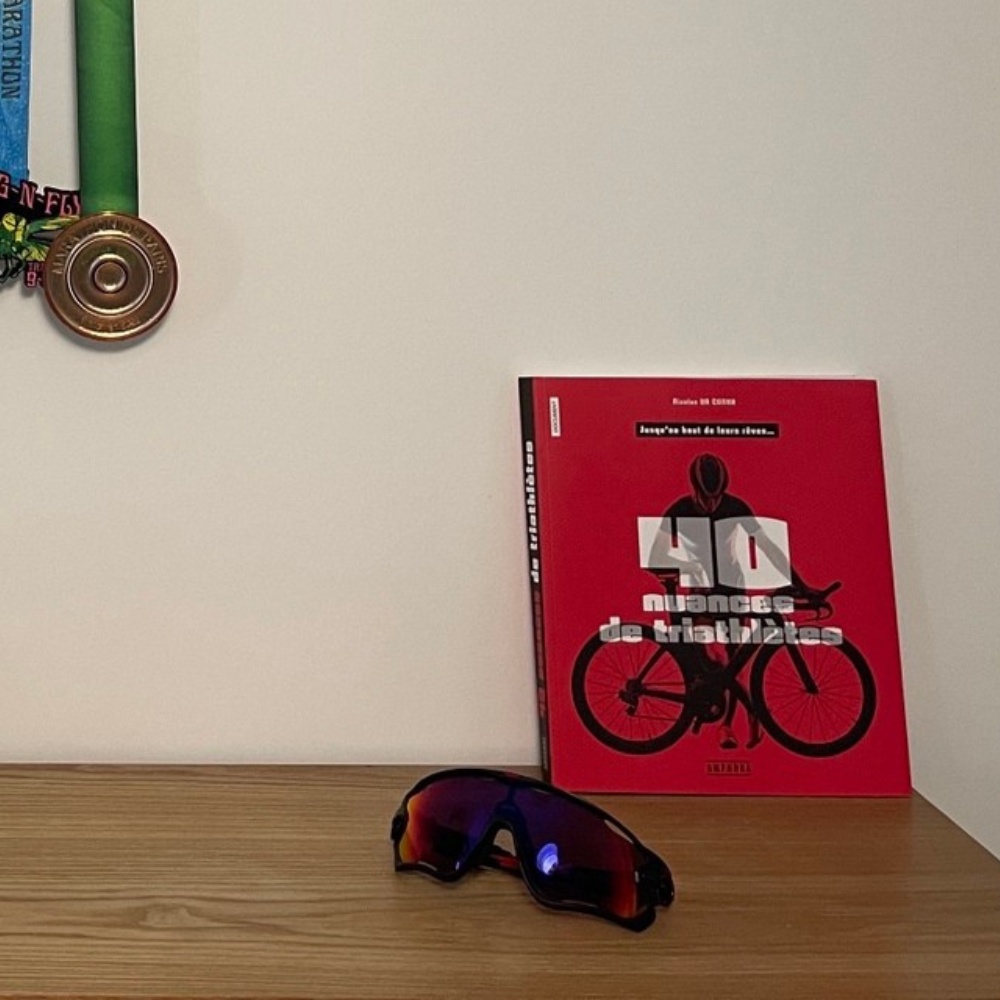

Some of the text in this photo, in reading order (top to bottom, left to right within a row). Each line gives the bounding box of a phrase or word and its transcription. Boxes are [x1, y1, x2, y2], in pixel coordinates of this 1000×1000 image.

[637, 516, 793, 590] 40
[530, 558, 540, 583] de
[642, 593, 795, 614] nuances
[599, 616, 844, 646] de triathlètes
